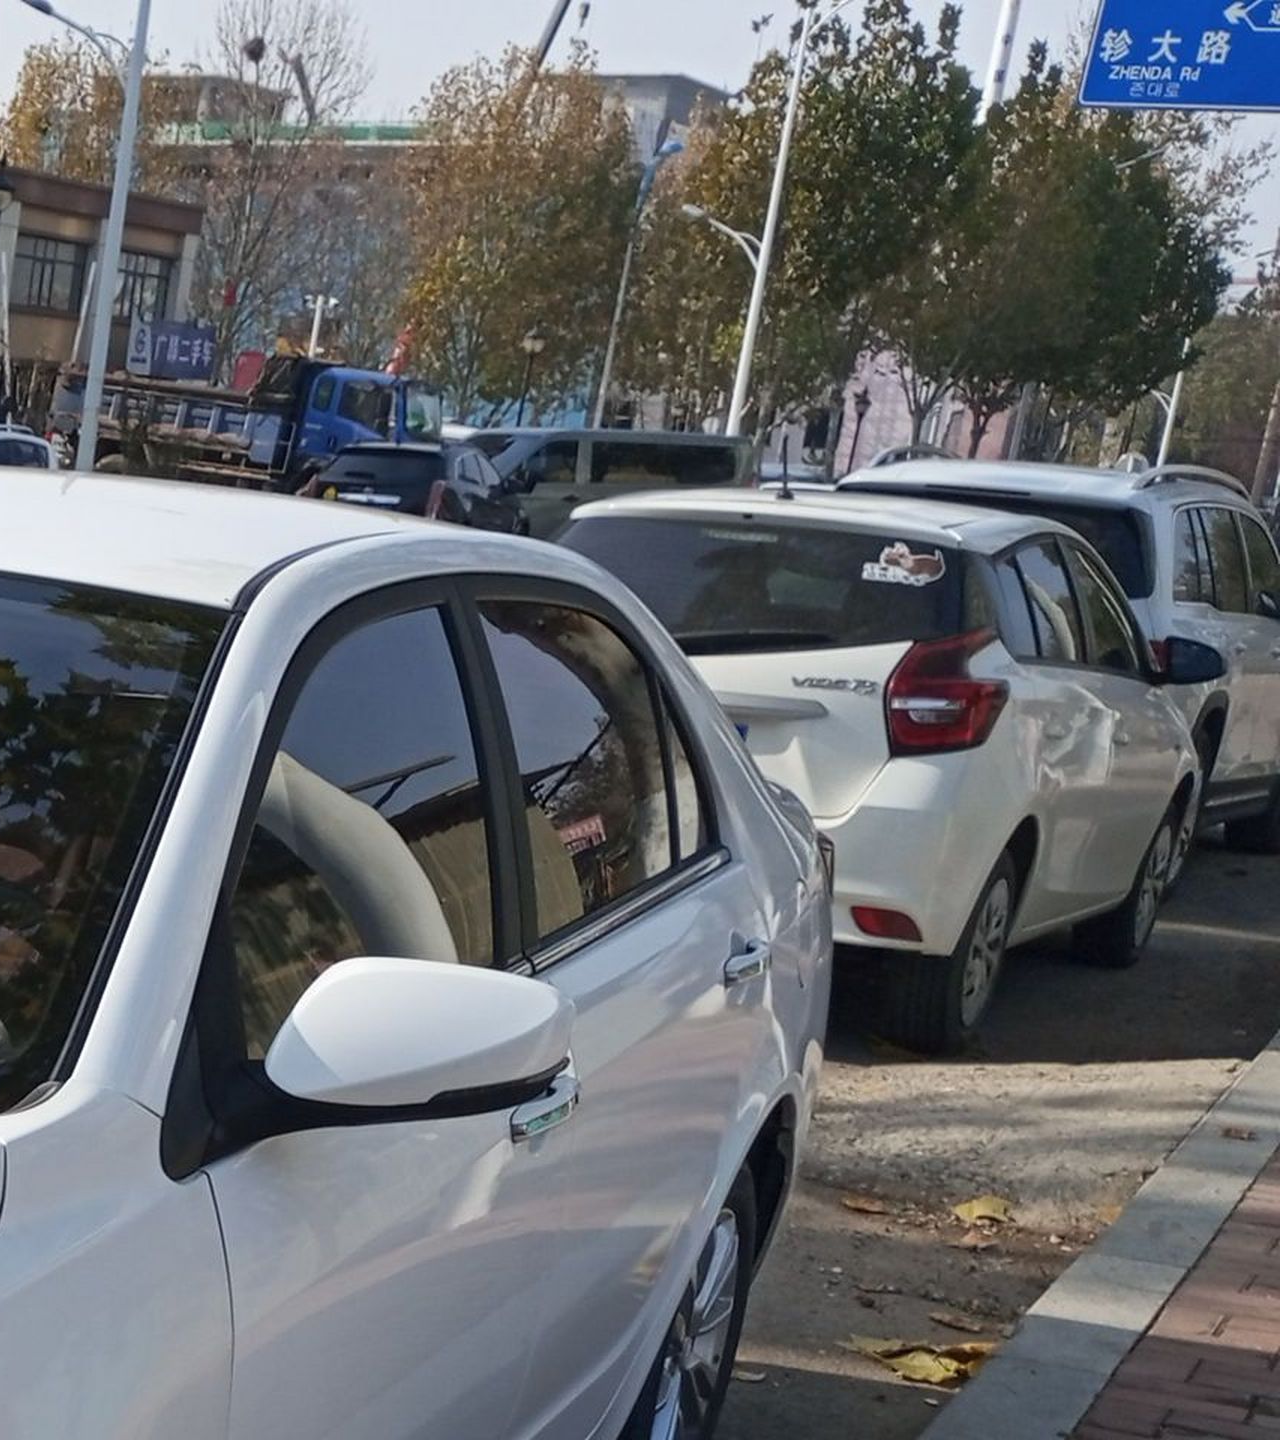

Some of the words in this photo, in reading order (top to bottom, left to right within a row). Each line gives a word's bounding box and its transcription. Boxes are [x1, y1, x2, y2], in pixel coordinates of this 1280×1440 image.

[1099, 28, 1232, 65] 轸大路
[1108, 65, 1172, 81] ZHENDA
[1179, 66, 1202, 82] Rd
